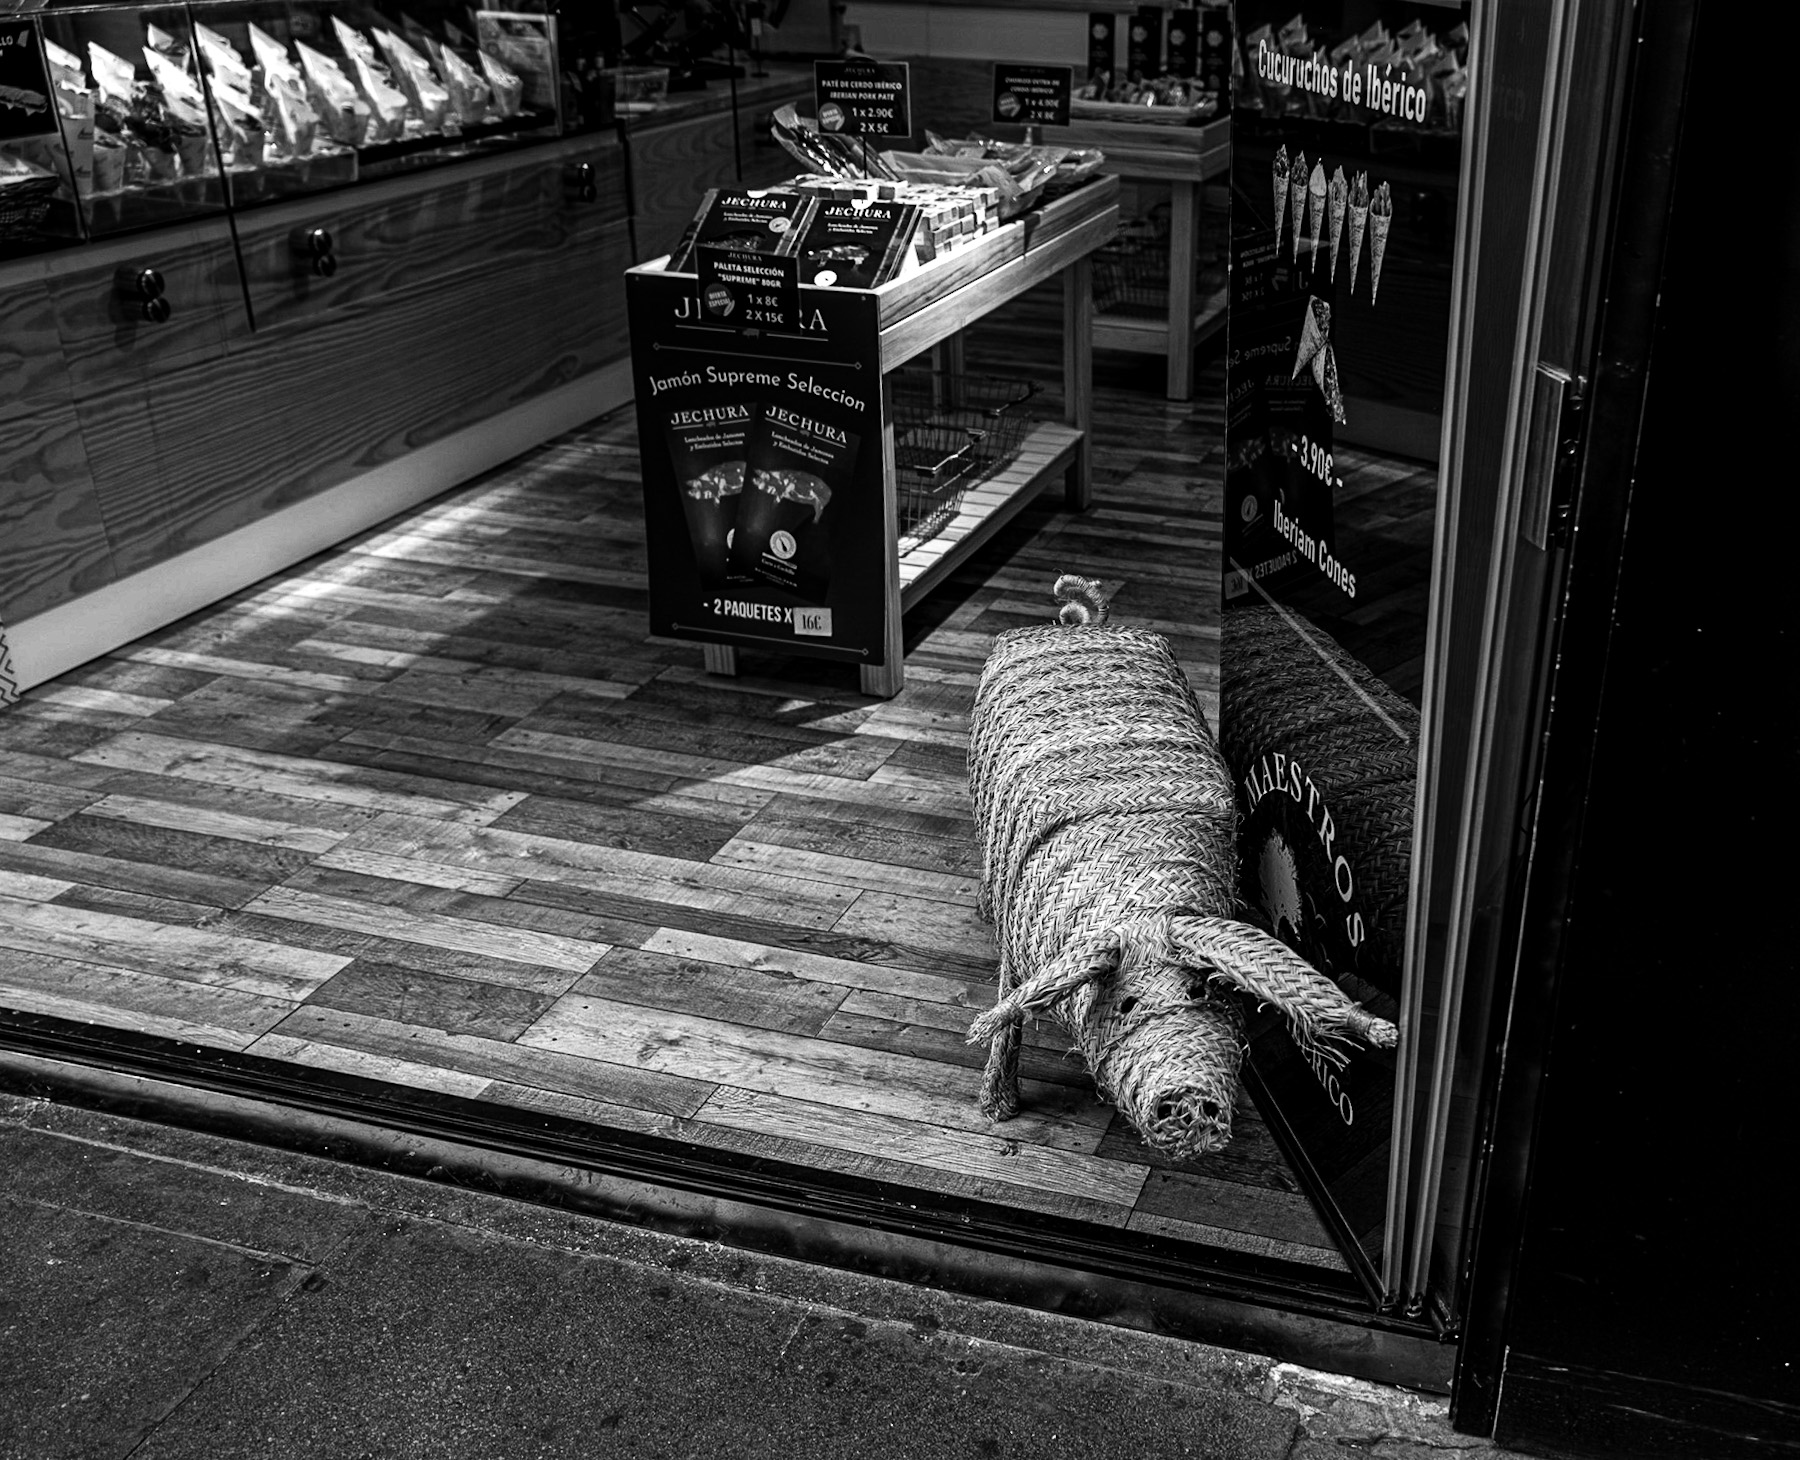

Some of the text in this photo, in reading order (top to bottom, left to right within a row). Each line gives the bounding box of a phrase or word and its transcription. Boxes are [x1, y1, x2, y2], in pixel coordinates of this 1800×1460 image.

[821, 79, 839, 88] PATÉ
[839, 80, 849, 88] DE
[850, 80, 873, 89] CERDO
[1258, 38, 1426, 123] Cucuruchos de Ibérico
[829, 91, 857, 100] IBERIAN
[858, 92, 877, 101] PORK
[852, 107, 858, 117] 1
[867, 107, 894, 119] 2.90€
[859, 122, 867, 132] 2
[877, 123, 889, 133] 5€
[721, 196, 788, 210] JECHURA
[824, 206, 892, 220] JECHURA
[713, 261, 785, 278] PALETA SELECCIÓN
[717, 273, 760, 285] "SUPREME"
[747, 293, 753, 304] 1
[764, 295, 779, 307] 8€
[745, 309, 753, 320] 2
[764, 312, 784, 324] 15€
[650, 366, 865, 411] Jamón Supreme Seleccion
[671, 404, 750, 425] JECHURA
[765, 406, 847, 444] JECHURA
[1301, 435, 1333, 487] 3.90€
[1273, 499, 1356, 599] Iberiam Cones
[713, 598, 722, 615] 2
[723, 599, 783, 623] PAQUETES
[783, 607, 793, 624] X
[1244, 752, 1365, 948] MAESTROS
